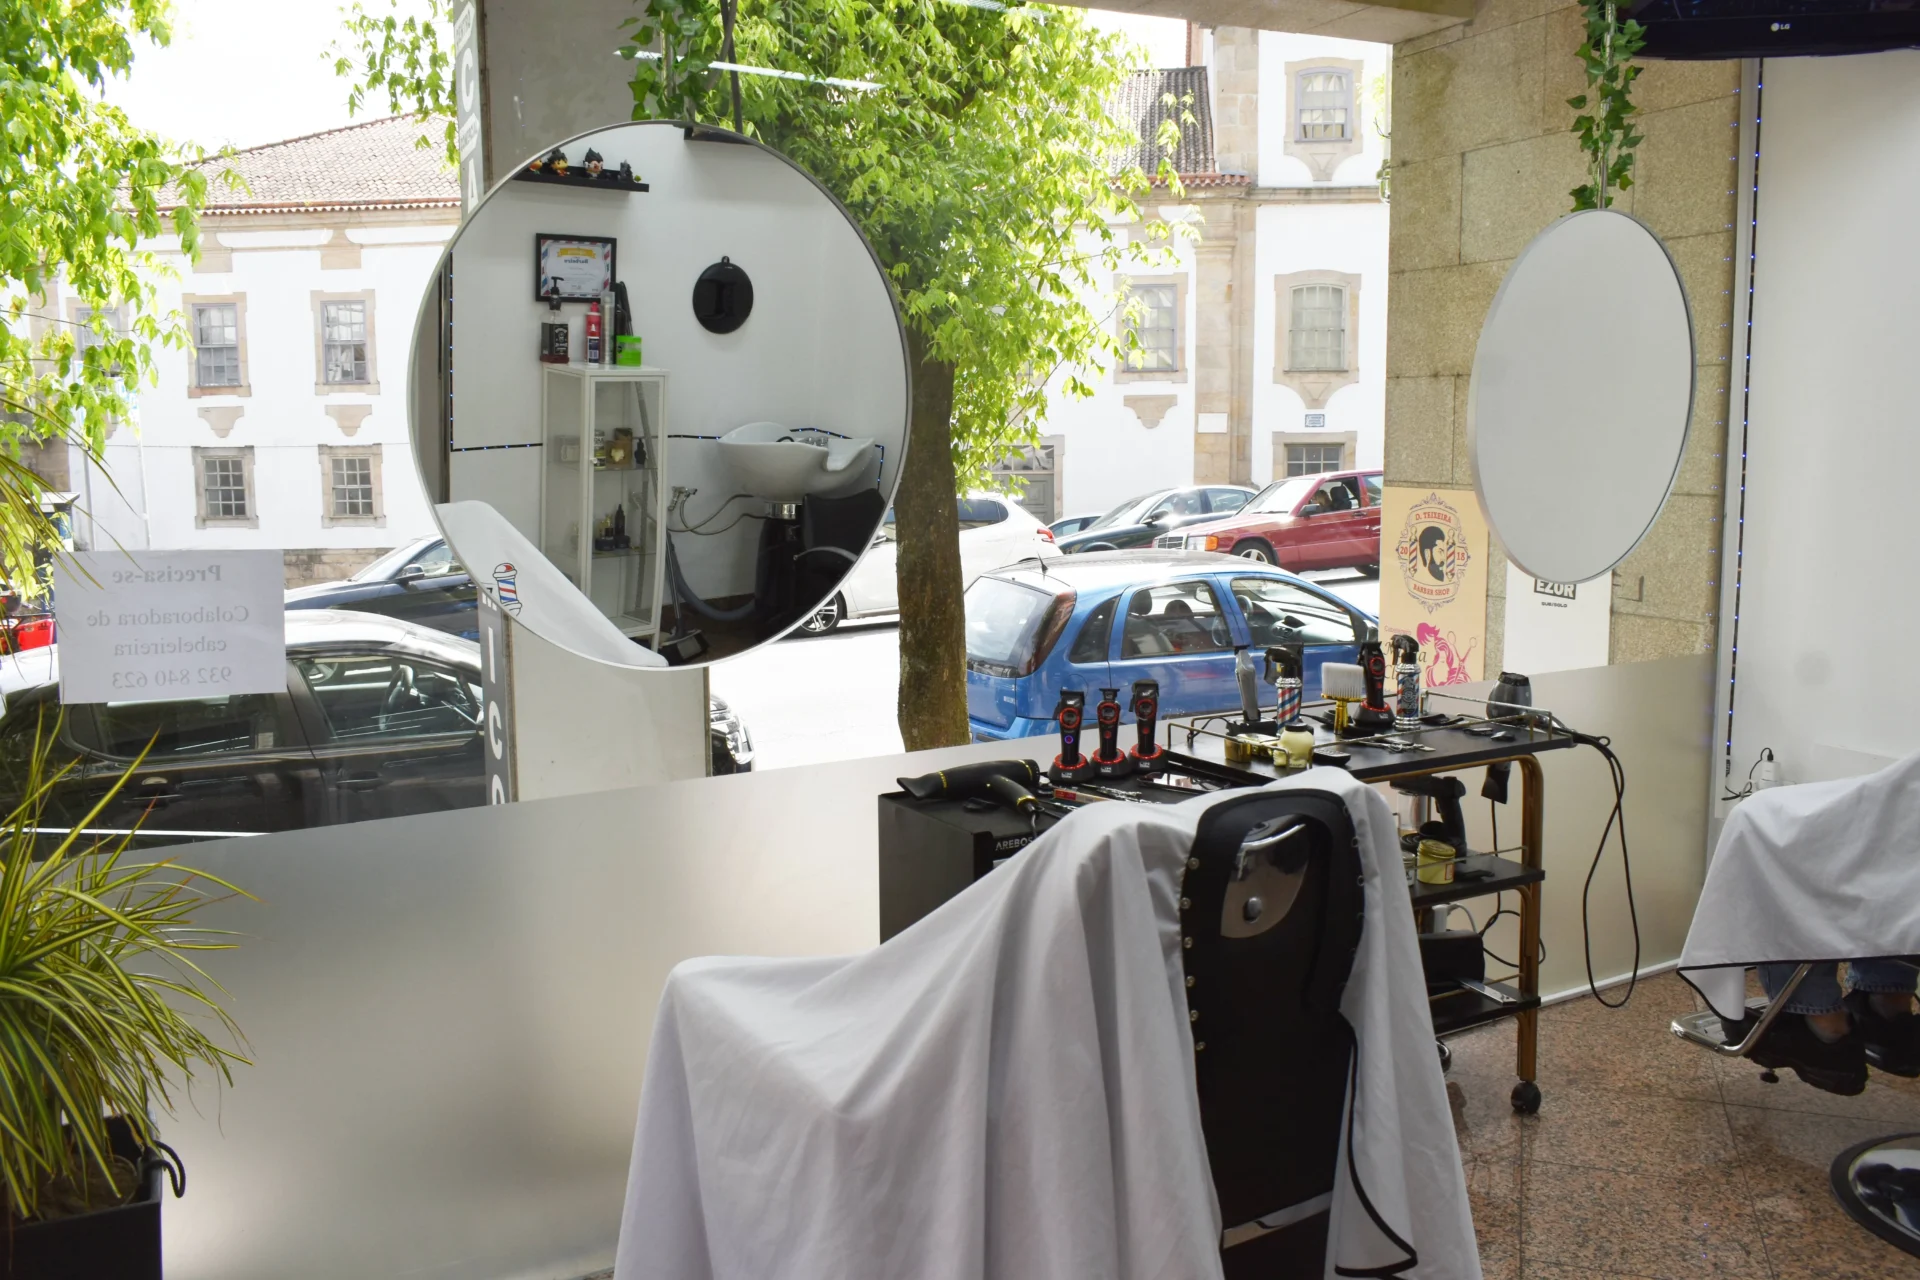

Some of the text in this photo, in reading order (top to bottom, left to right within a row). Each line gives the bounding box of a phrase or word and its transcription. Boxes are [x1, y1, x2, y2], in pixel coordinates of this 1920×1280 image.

[1423, 512, 1452, 523] TEIXEIRA
[1400, 546, 1466, 561] 20 18
[1413, 584, 1450, 596] BARBER SHOP
